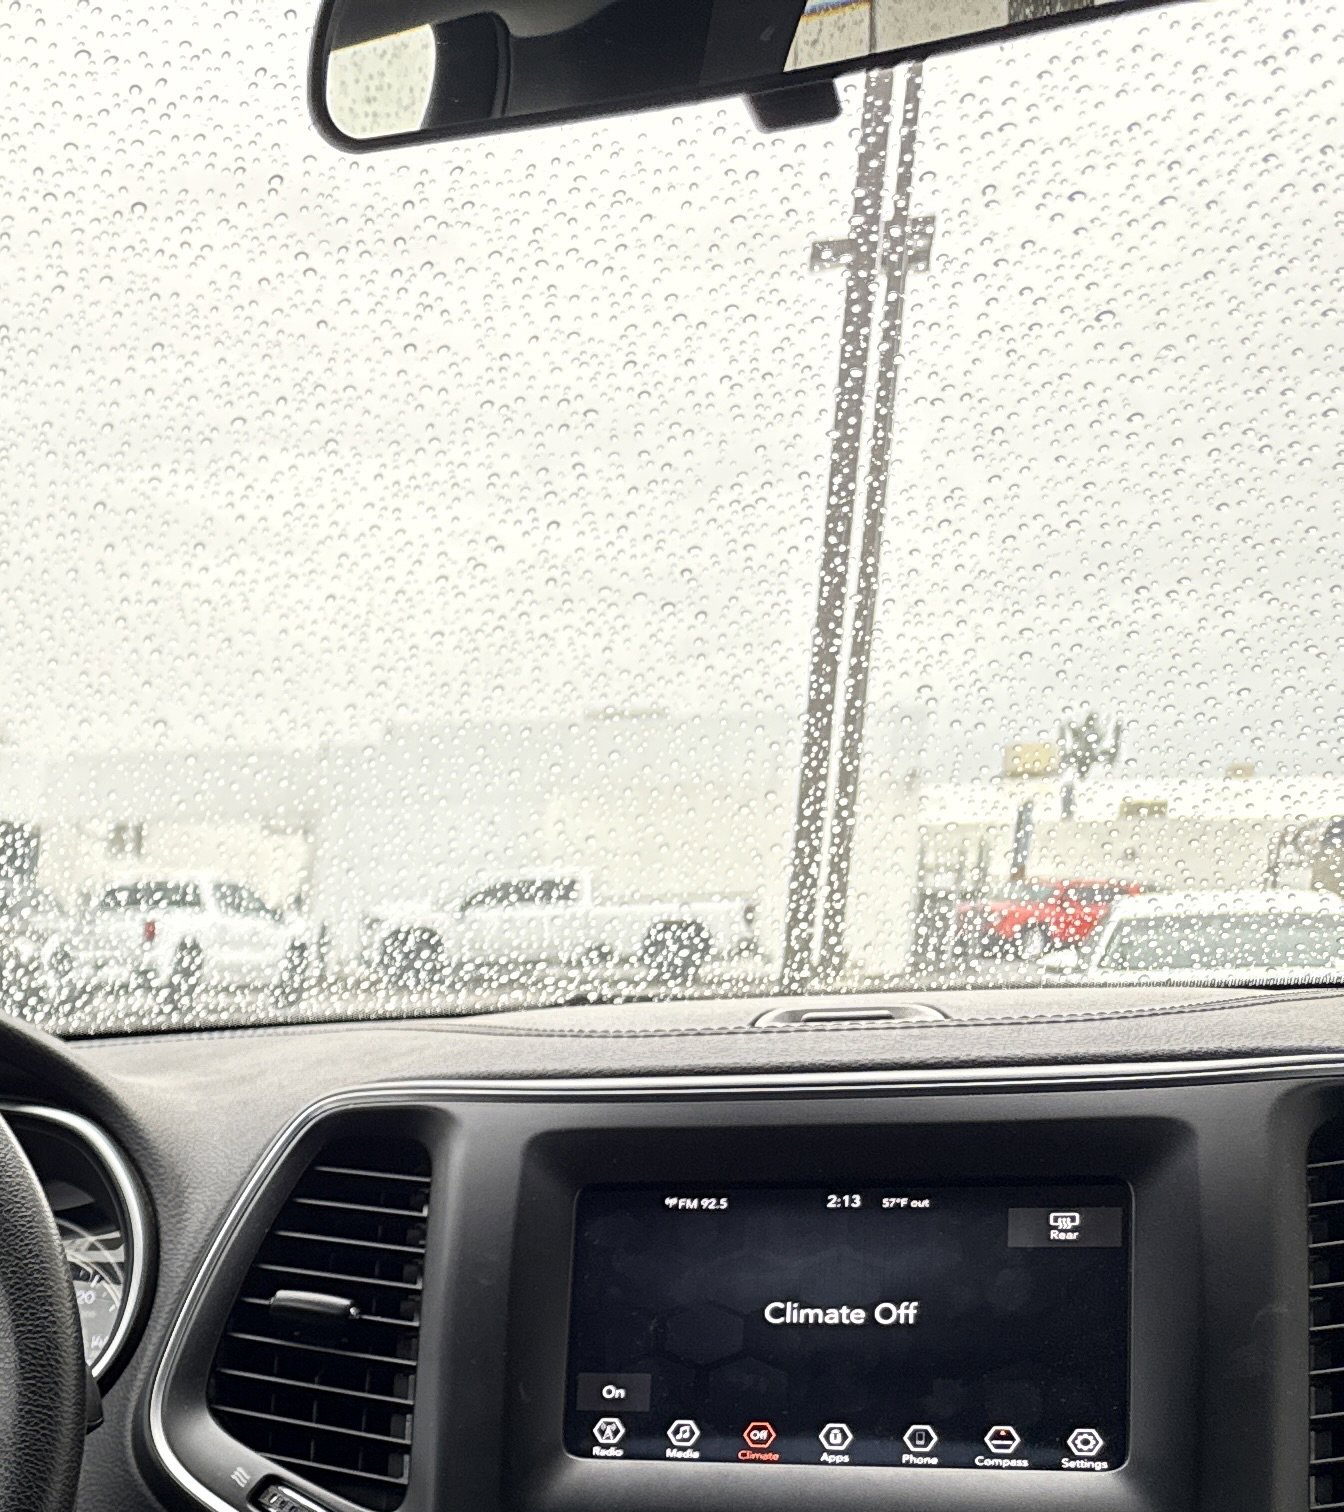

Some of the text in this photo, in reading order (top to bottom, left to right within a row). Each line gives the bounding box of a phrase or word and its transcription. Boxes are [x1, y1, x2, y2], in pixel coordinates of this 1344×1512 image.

[678, 1197, 728, 1210] FM 92.5
[826, 1194, 861, 1208] 2:13
[881, 1197, 930, 1209] 57°F out
[1050, 1230, 1079, 1240] Rear
[76, 1289, 96, 1305] 20
[764, 1301, 919, 1325] Climate Off
[602, 1384, 627, 1400] On
[749, 1429, 769, 1441] Off
[592, 1446, 624, 1457] Radio
[665, 1448, 700, 1460] Media
[737, 1450, 780, 1462] Climate
[820, 1452, 850, 1464] Apps
[902, 1453, 939, 1465] Phone
[974, 1456, 1029, 1468] Compass
[1061, 1458, 1108, 1471] Settings
